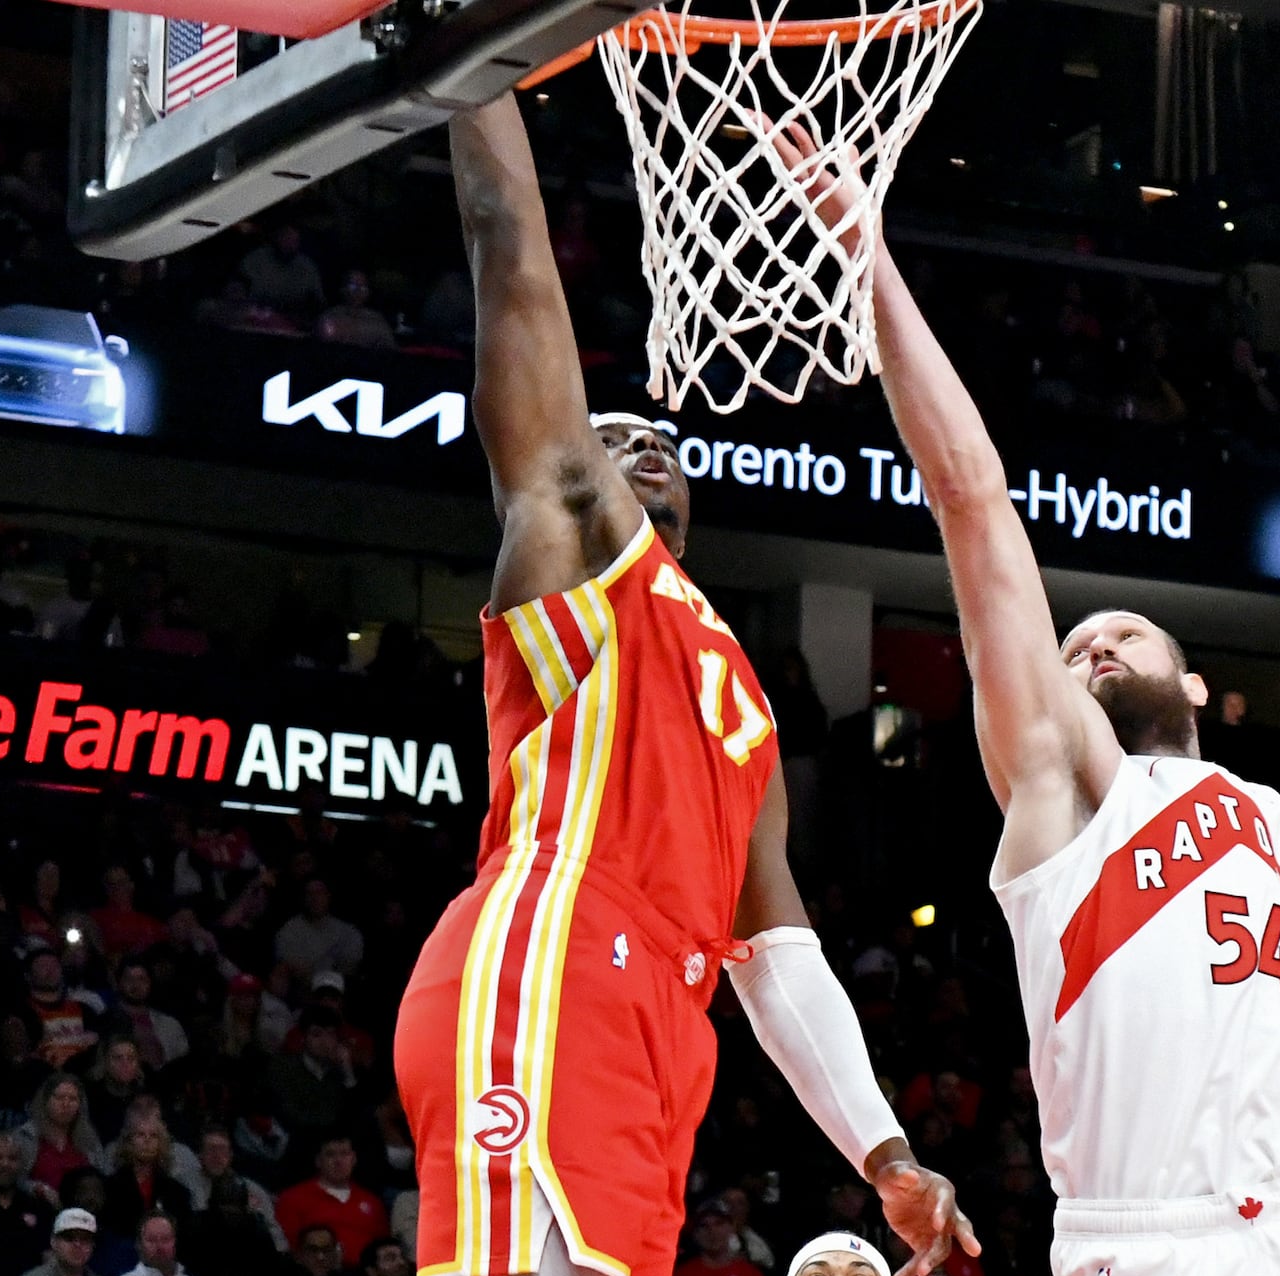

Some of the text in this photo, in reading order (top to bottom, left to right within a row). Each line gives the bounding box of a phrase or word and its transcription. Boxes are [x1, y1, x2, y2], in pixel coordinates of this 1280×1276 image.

[859, 447, 1193, 540] Tu-Hybrid
[25, 681, 232, 784] Farm
[234, 722, 465, 806] ARENA
